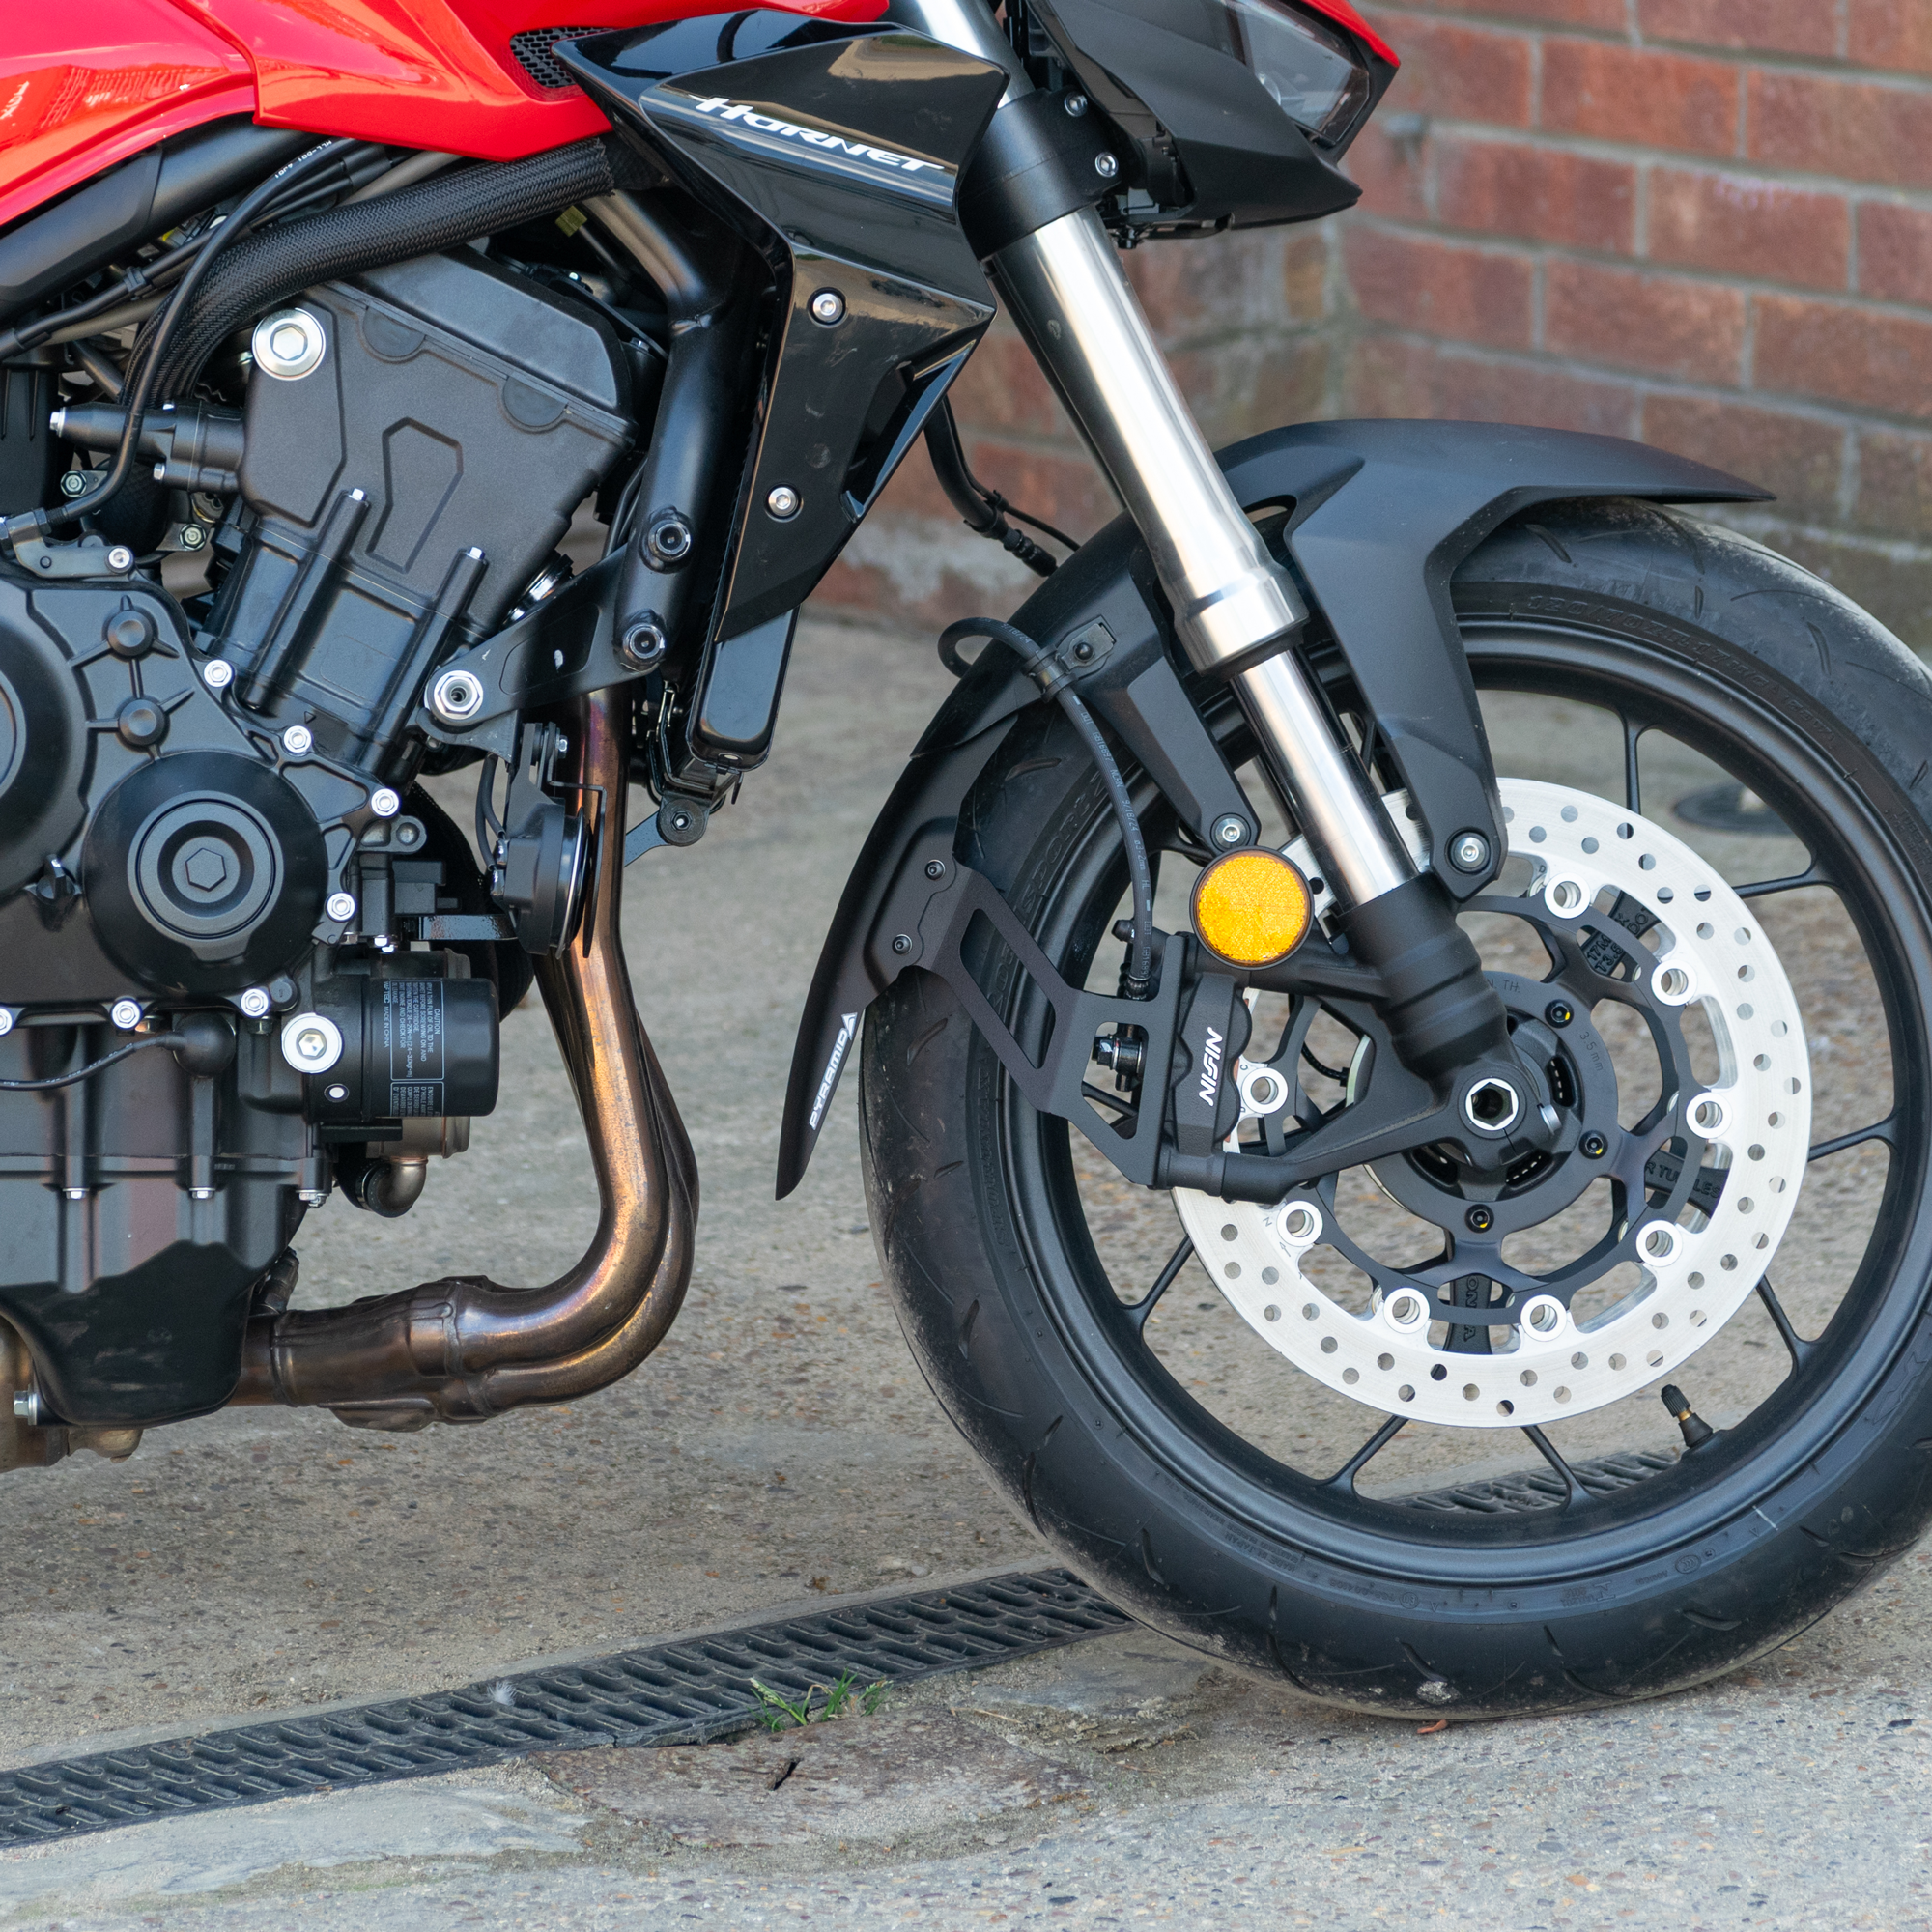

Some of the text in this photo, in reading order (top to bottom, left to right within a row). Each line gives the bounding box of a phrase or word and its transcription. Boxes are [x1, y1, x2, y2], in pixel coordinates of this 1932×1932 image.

[689, 94, 945, 171] HORNET
[420, 1039, 426, 1048] ON
[809, 1027, 849, 1131] PYRAMID
